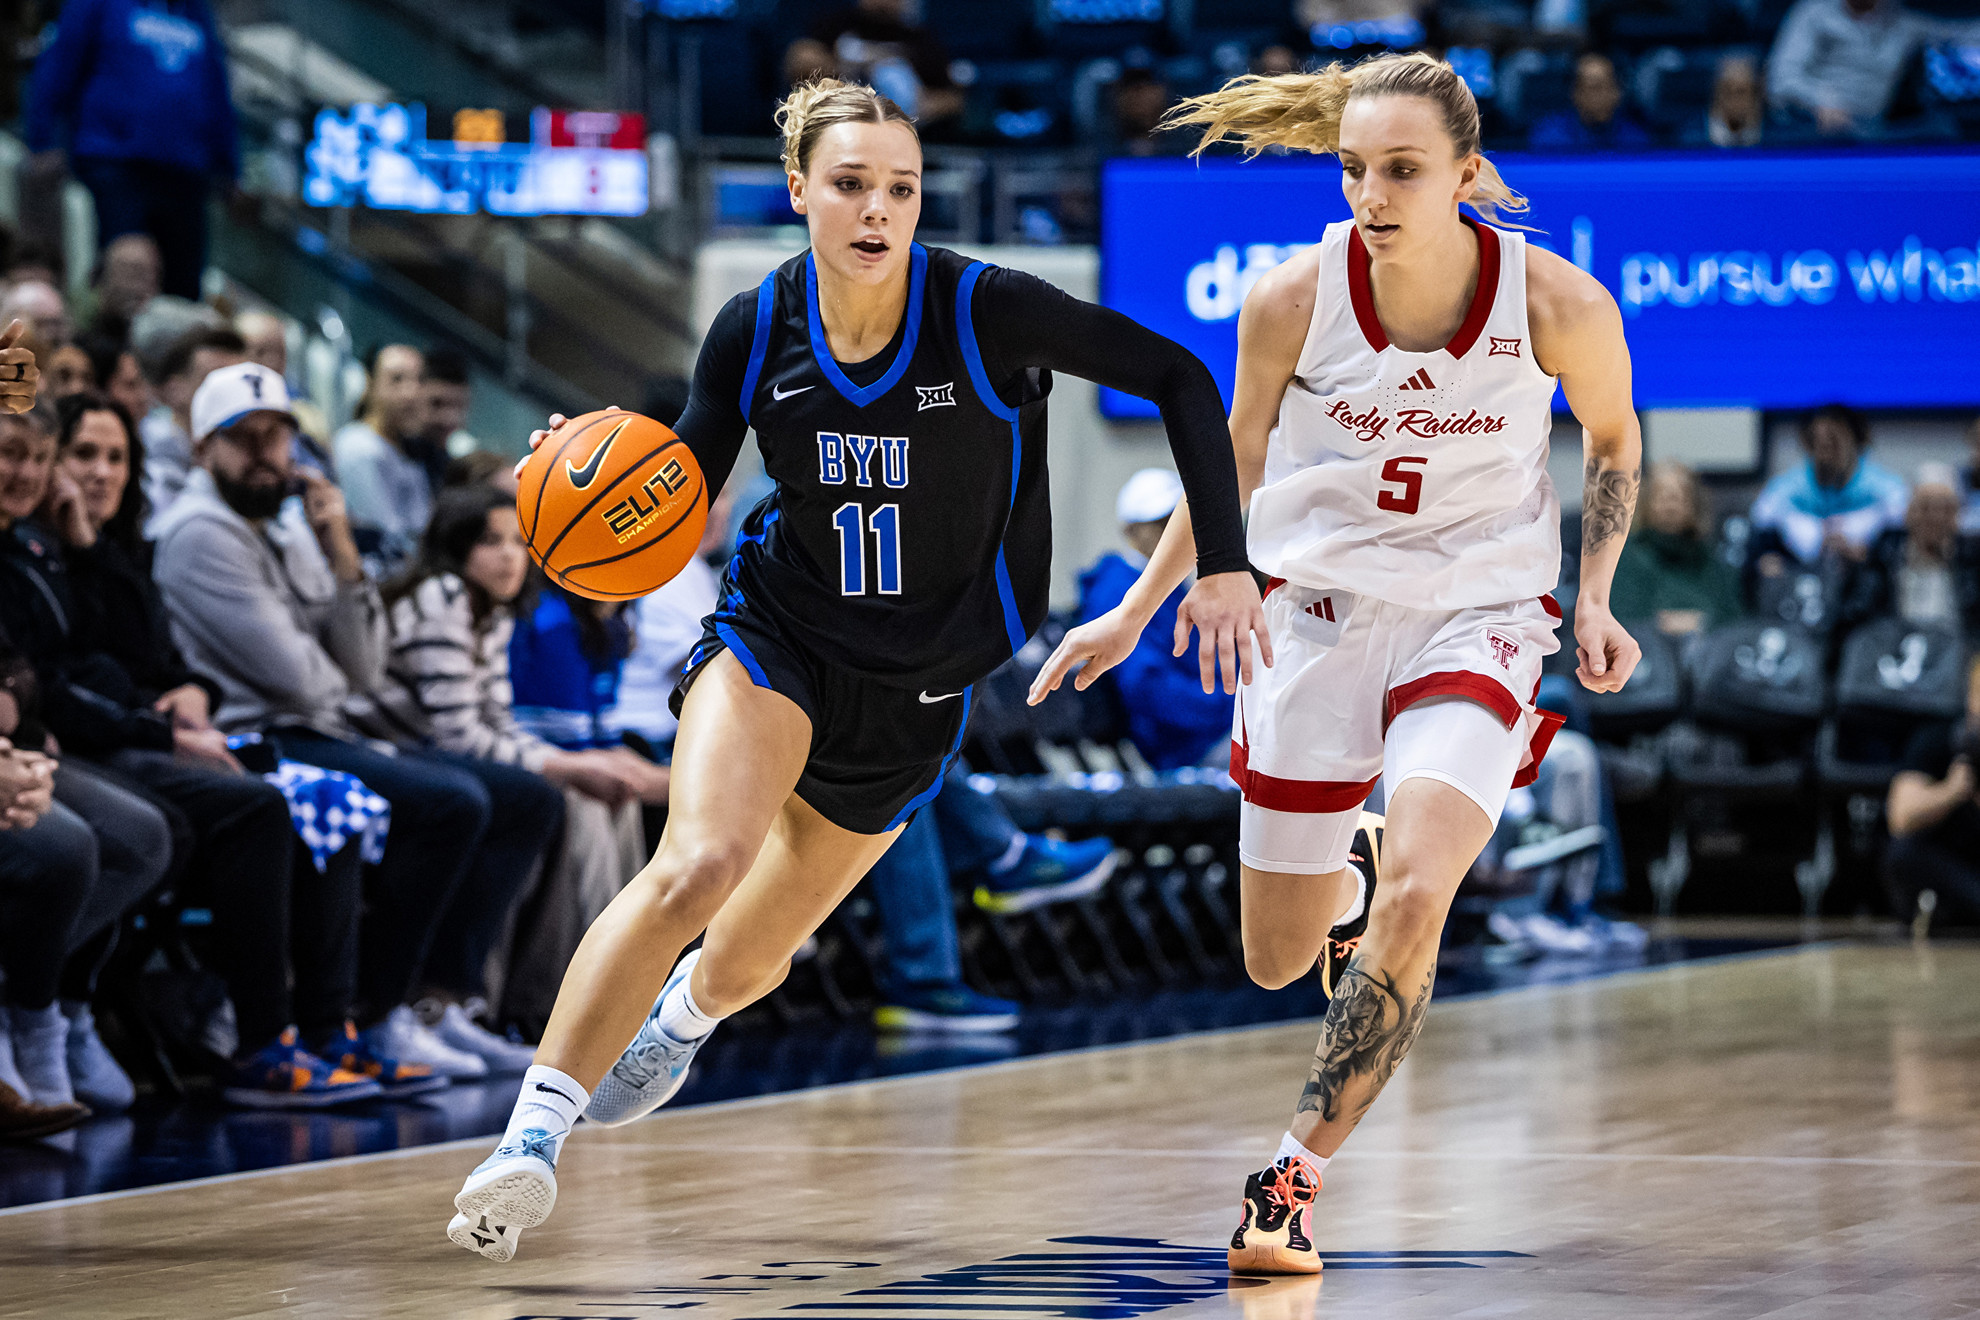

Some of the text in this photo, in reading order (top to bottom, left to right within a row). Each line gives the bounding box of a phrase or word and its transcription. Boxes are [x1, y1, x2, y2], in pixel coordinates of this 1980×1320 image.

[1621, 234, 1980, 320] pursue wha
[1324, 400, 1509, 442] Lady Raiders
[817, 431, 909, 489] BYU
[1376, 456, 1429, 515] 5
[832, 501, 902, 597] 11
